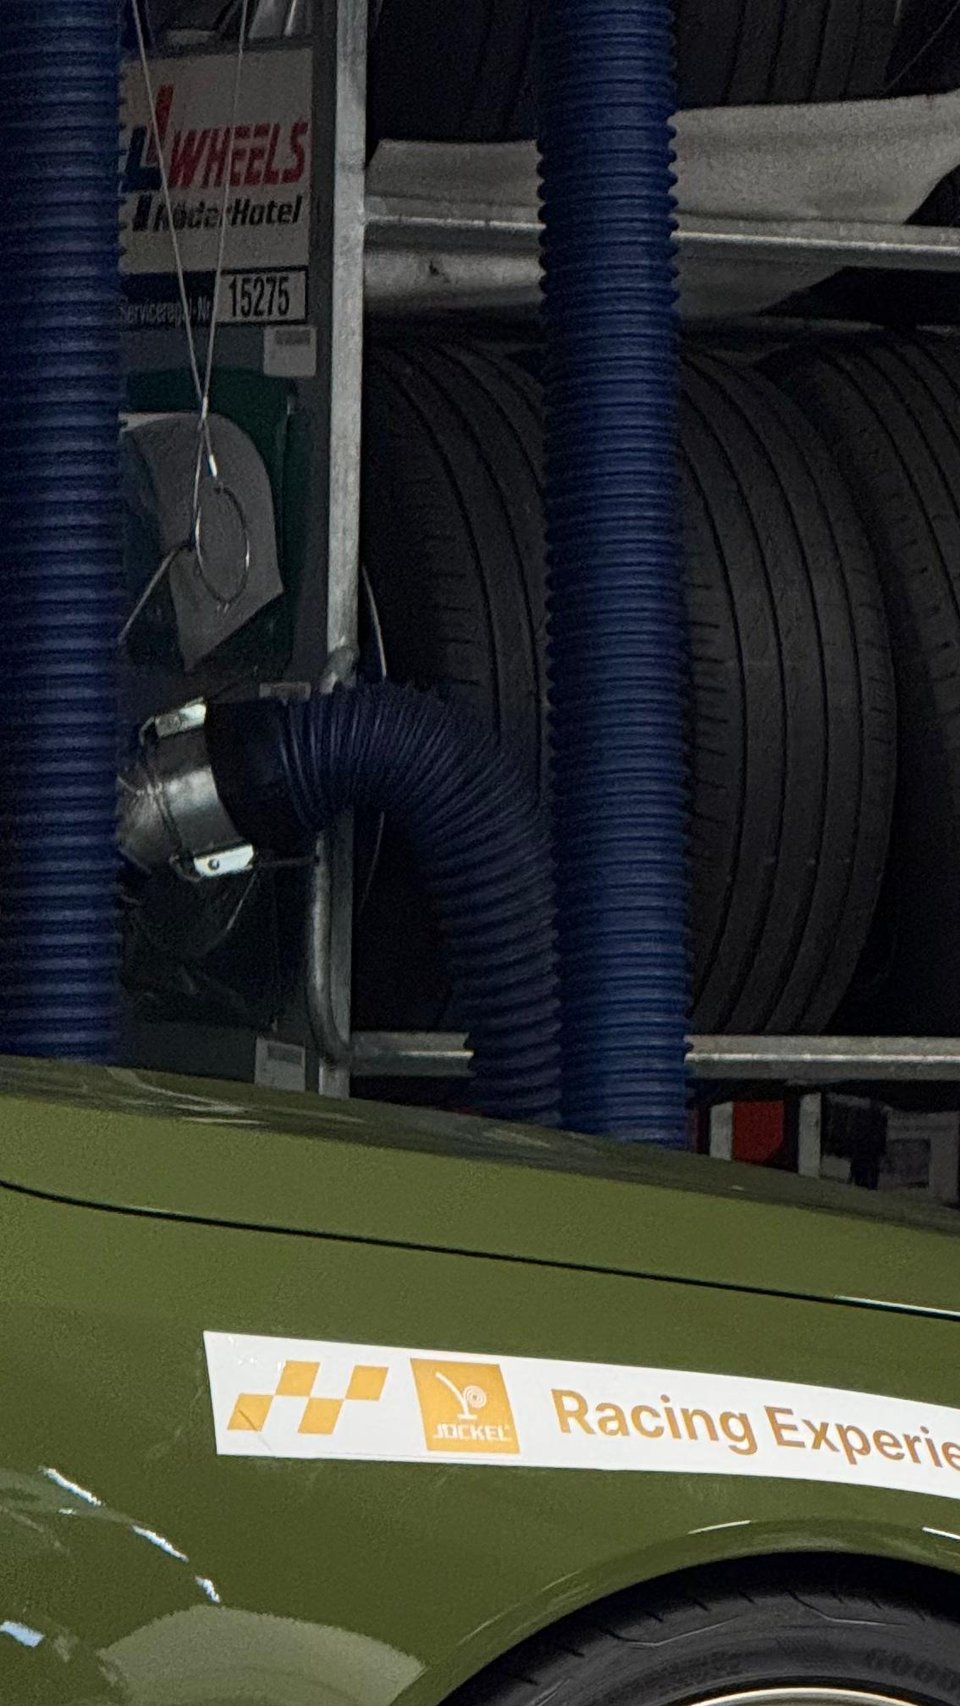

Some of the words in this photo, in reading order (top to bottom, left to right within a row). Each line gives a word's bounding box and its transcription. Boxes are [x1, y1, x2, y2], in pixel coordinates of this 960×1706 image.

[229, 276, 290, 318] 15275
[432, 1423, 513, 1442] JOCKEL
[551, 1388, 758, 1456] Racing
